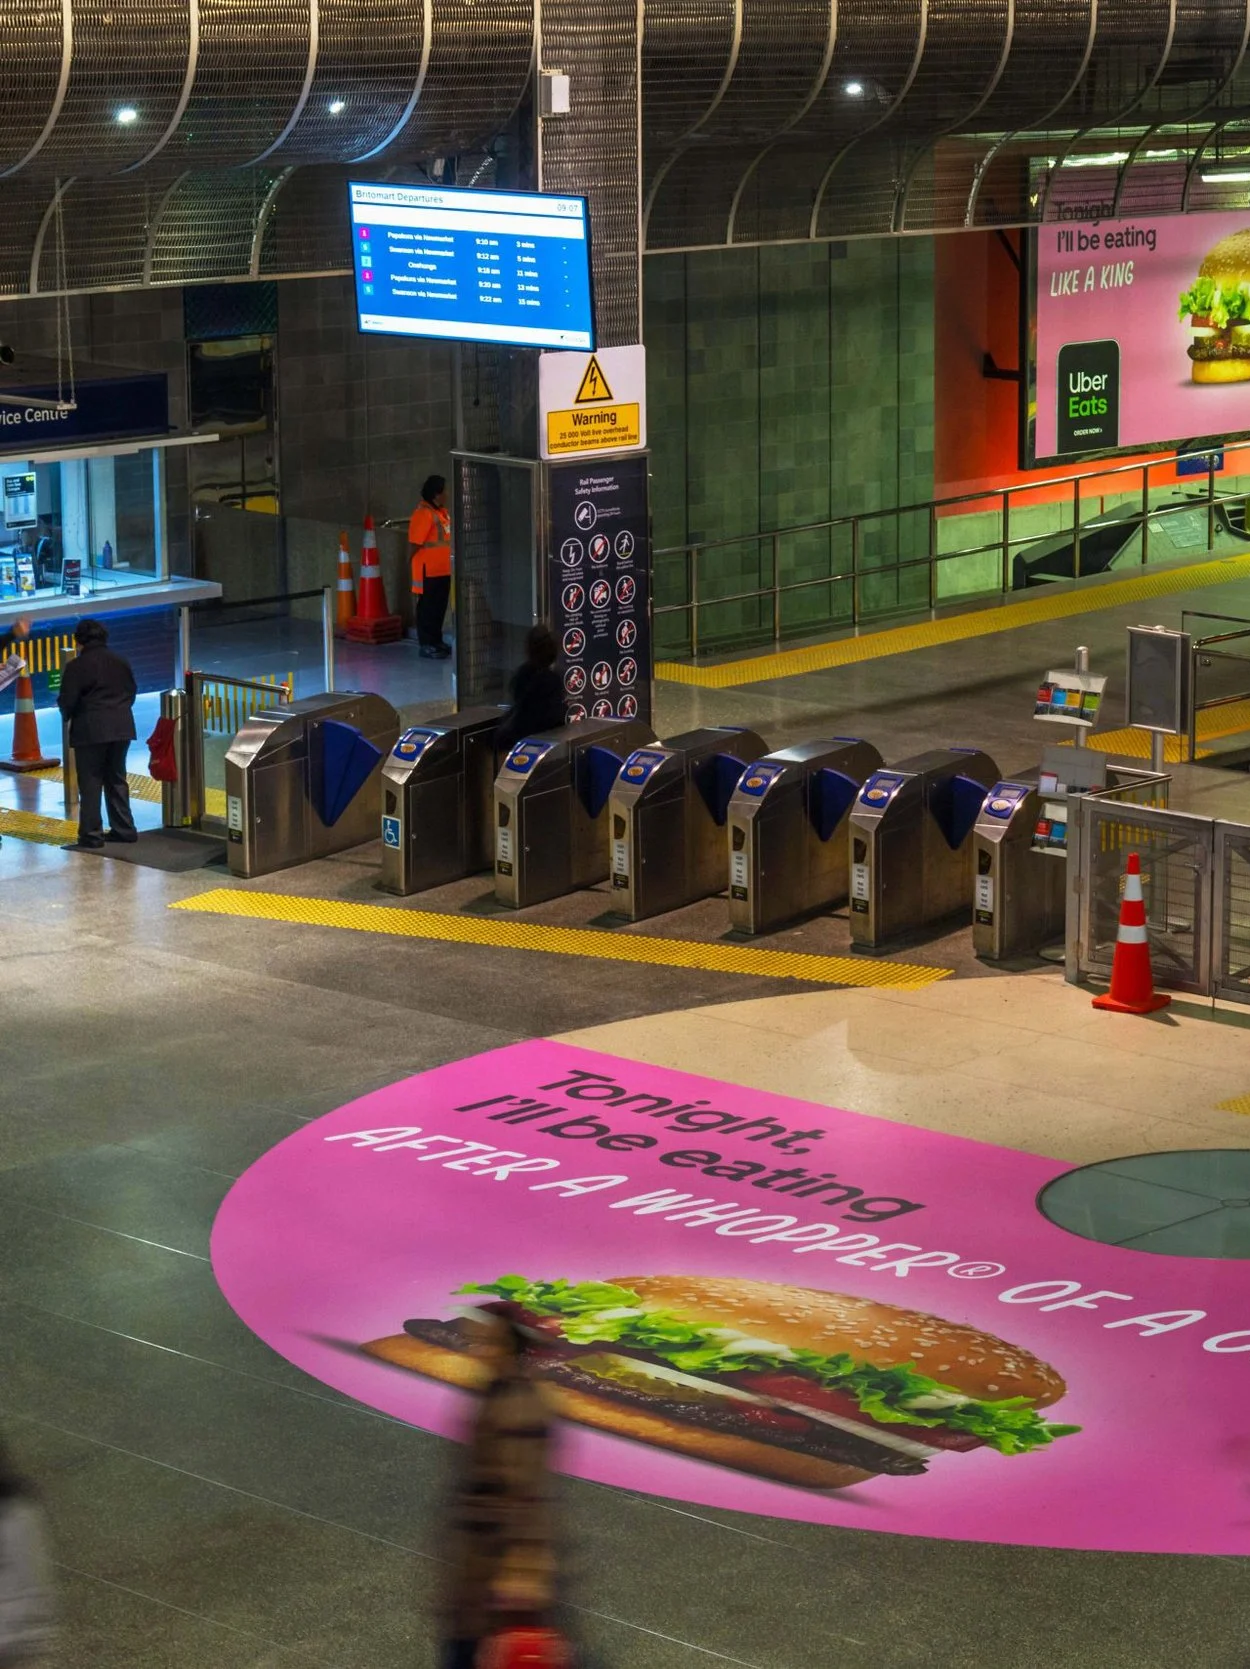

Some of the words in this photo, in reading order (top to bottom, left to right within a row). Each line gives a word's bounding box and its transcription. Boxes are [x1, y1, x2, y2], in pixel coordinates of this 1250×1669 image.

[356, 190, 395, 200] Britomart
[397, 192, 444, 204] Departures
[1057, 230, 1074, 253] I'll
[1078, 229, 1101, 252] be
[1104, 227, 1157, 251] eating
[1050, 269, 1080, 297] LIKE
[1084, 265, 1095, 293] A
[1100, 259, 1134, 290] KING
[1069, 371, 1108, 394] Uber
[0, 410, 21, 425] ice
[25, 406, 69, 424] Centre
[1069, 395, 1108, 418] Eats
[572, 411, 617, 426] Warning
[550, 440, 579, 450] conductor
[580, 438, 600, 447] beams
[600, 436, 618, 444] above
[560, 432, 567, 440] 25
[602, 426, 629, 435] overhead
[574, 487, 591, 496] Safety
[592, 484, 620, 494] Information
[538, 1069, 828, 1156] Tonight,
[453, 1094, 567, 1136] I'll
[541, 1114, 659, 1153] be
[659, 1148, 928, 1224] eating
[324, 1126, 561, 1182] AFTER
[529, 1174, 629, 1198] A
[998, 1280, 1135, 1313] OF
[1103, 1309, 1208, 1338] A
